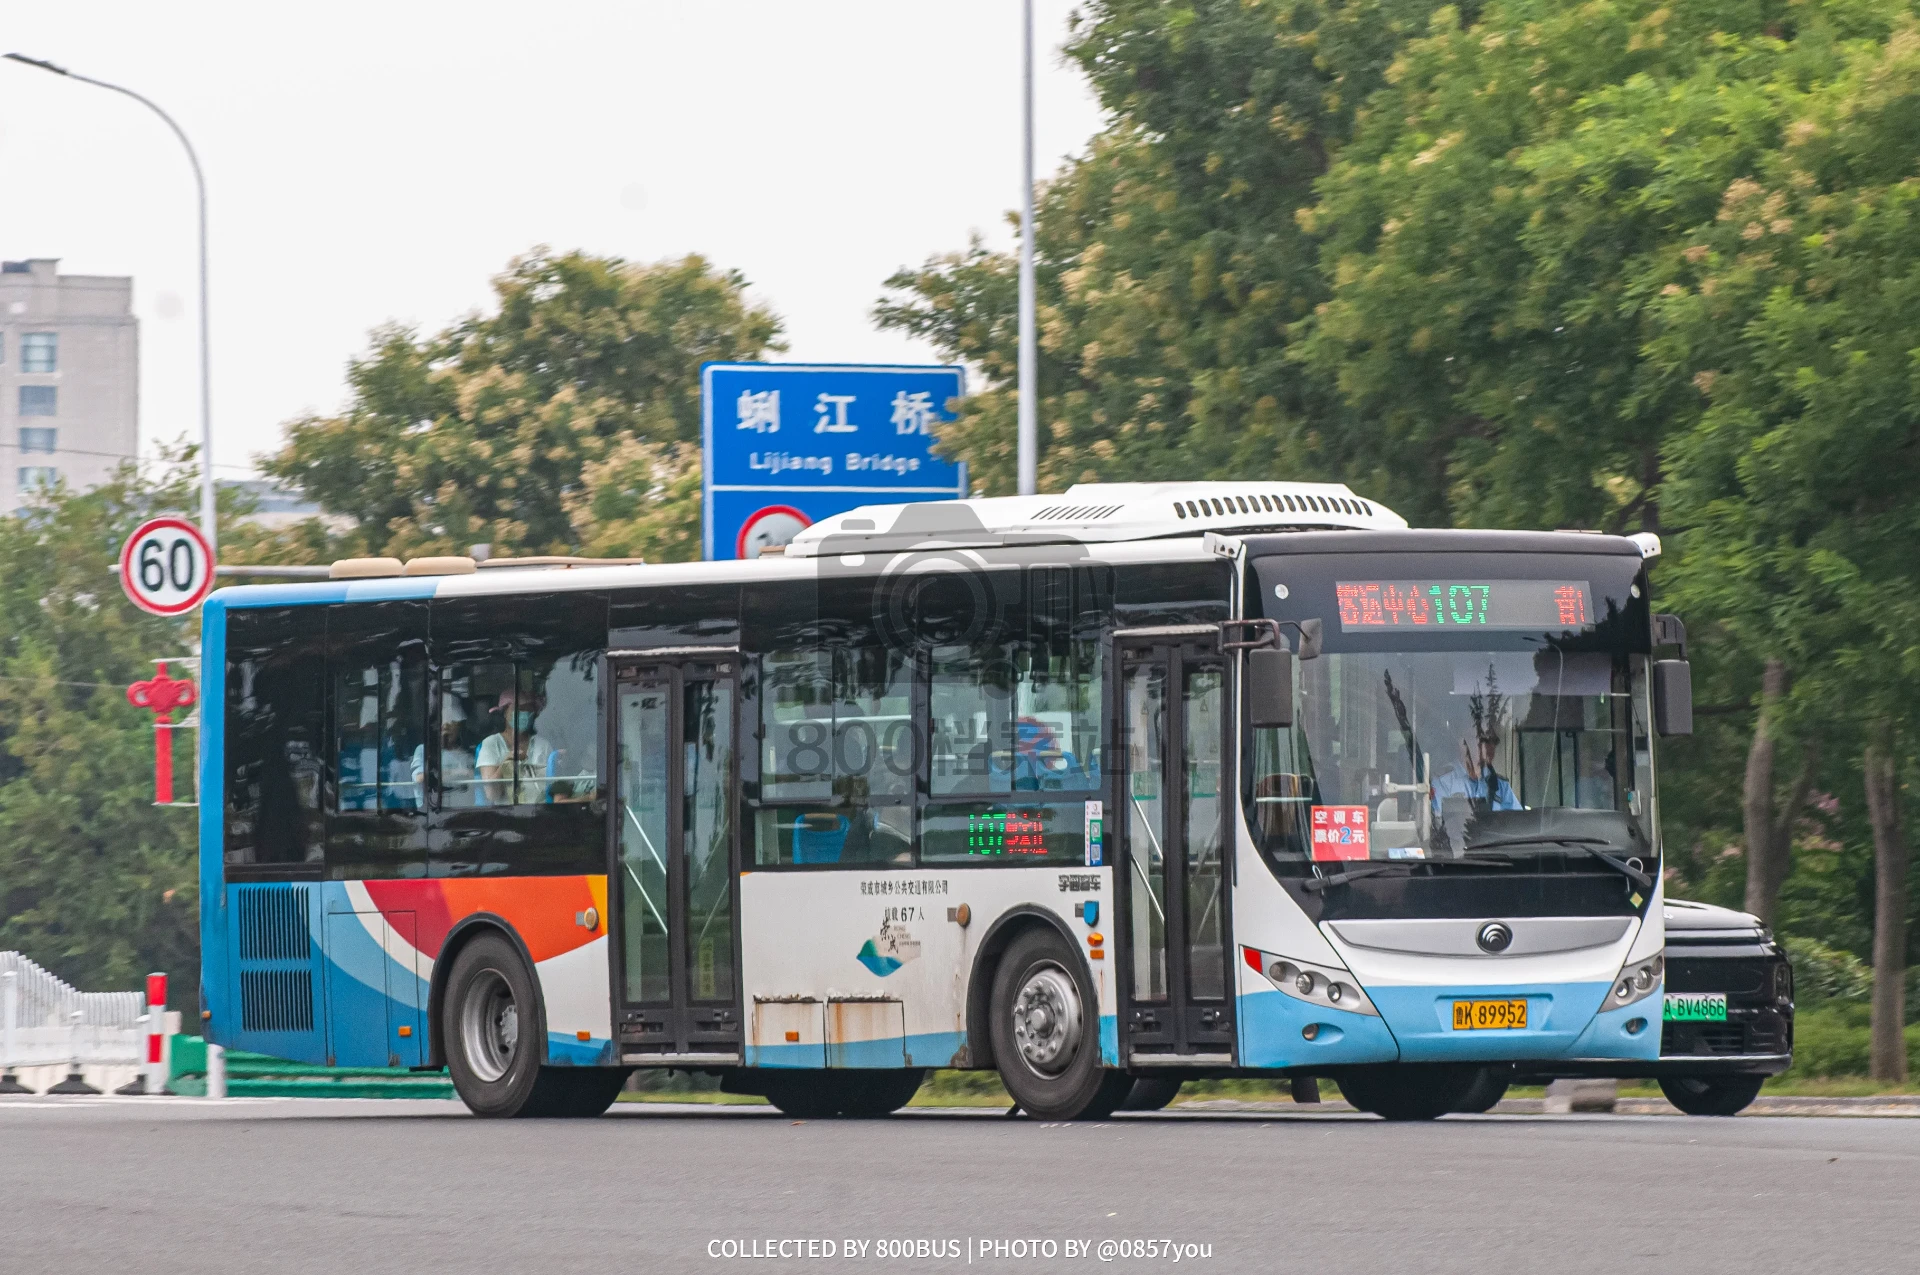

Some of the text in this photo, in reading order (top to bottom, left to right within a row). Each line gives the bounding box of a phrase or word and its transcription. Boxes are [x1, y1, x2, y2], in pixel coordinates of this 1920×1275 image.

[736, 389, 935, 435] 蜊江桥
[750, 452, 921, 476] Lijiang Bridge
[140, 538, 194, 592] 60
[1429, 584, 1490, 624] 107
[1314, 810, 1365, 825] 空调车
[1314, 826, 1366, 845] 票价2元
